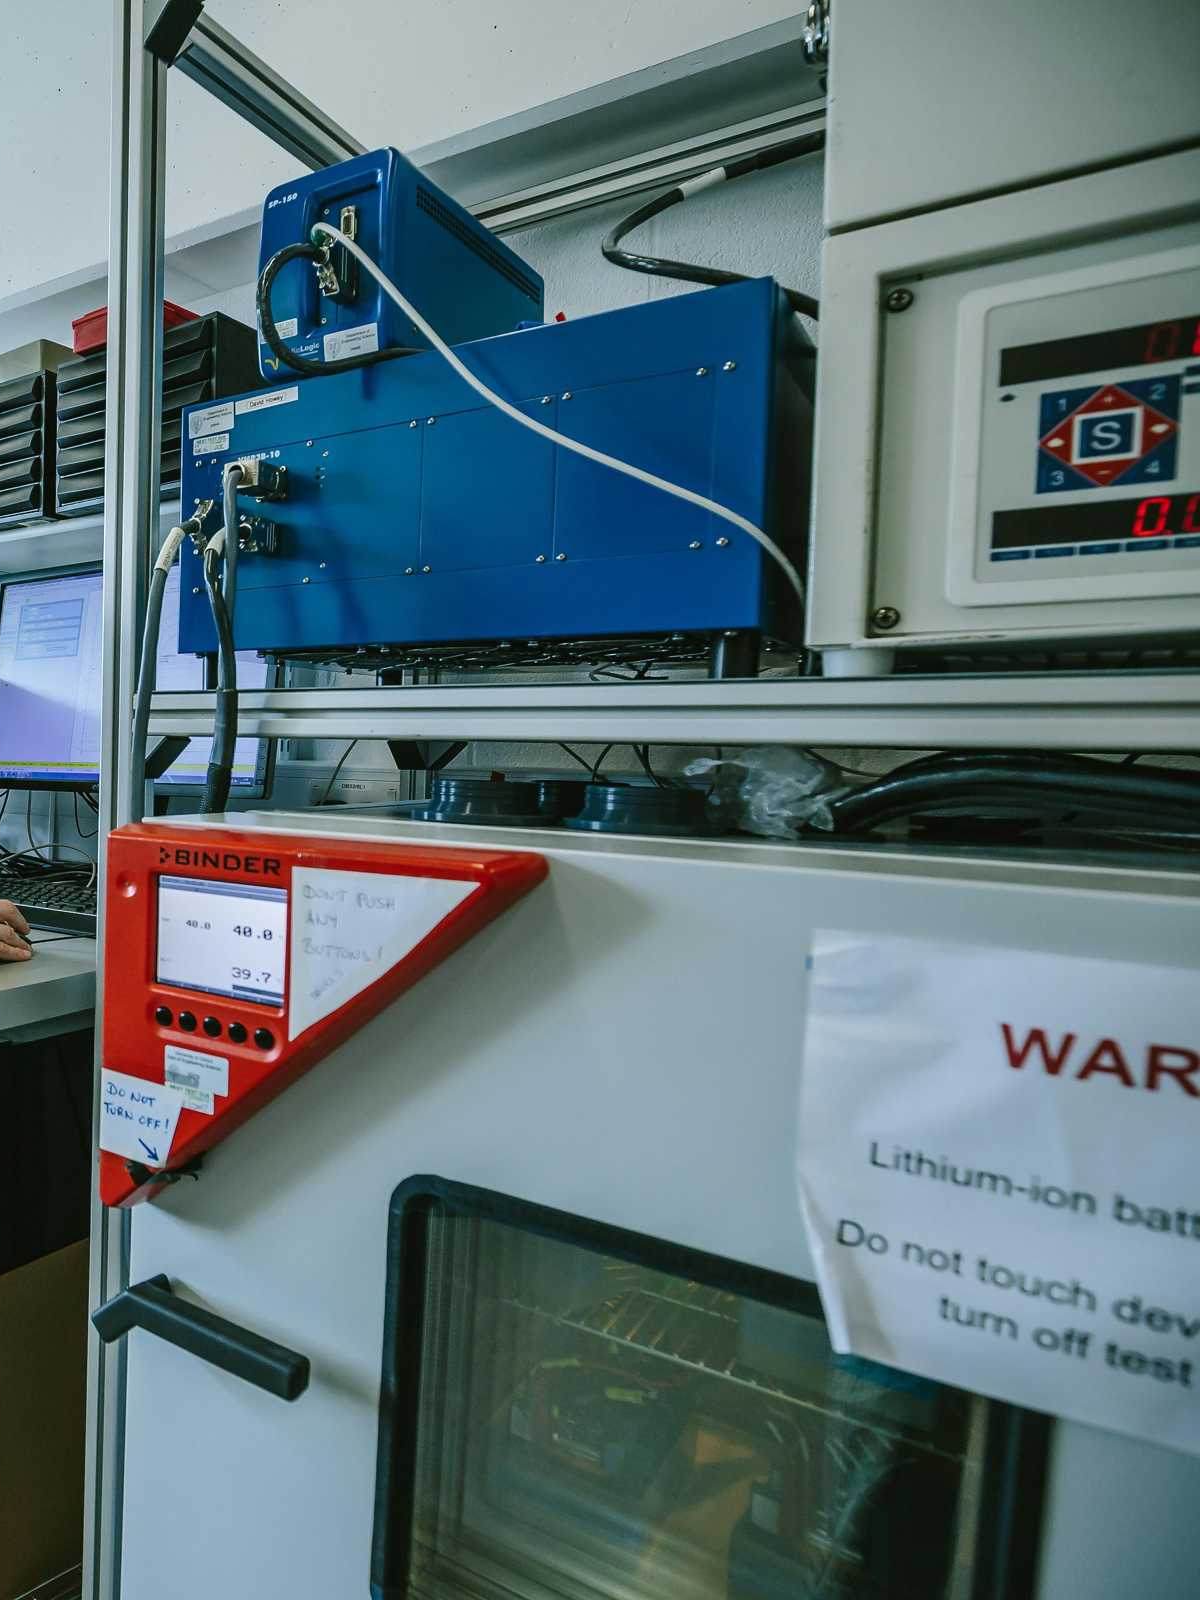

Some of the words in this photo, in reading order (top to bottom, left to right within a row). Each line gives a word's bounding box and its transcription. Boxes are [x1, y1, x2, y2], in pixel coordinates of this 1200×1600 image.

[1151, 384, 1166, 400] 2
[1058, 398, 1067, 411] 1
[1090, 421, 1121, 450] S
[1051, 470, 1065, 486] 3
[1145, 461, 1160, 474] 4
[175, 849, 282, 876] BINDER
[356, 890, 396, 912] PUSH
[185, 919, 211, 930] 40.0
[232, 925, 273, 941] 40.0
[304, 909, 339, 929] ANY
[232, 966, 272, 984] 39.7
[106, 1082, 126, 1097] DO
[130, 1091, 156, 1107] NOT
[103, 1102, 133, 1120] TURN
[869, 1141, 1097, 1216] Lithium-ion
[836, 1219, 889, 1255] Do
[901, 1242, 963, 1276] not
[976, 1257, 1097, 1313] touch
[938, 1297, 1019, 1341] turn
[1033, 1327, 1093, 1360] off
[1104, 1342, 1194, 1388] test
